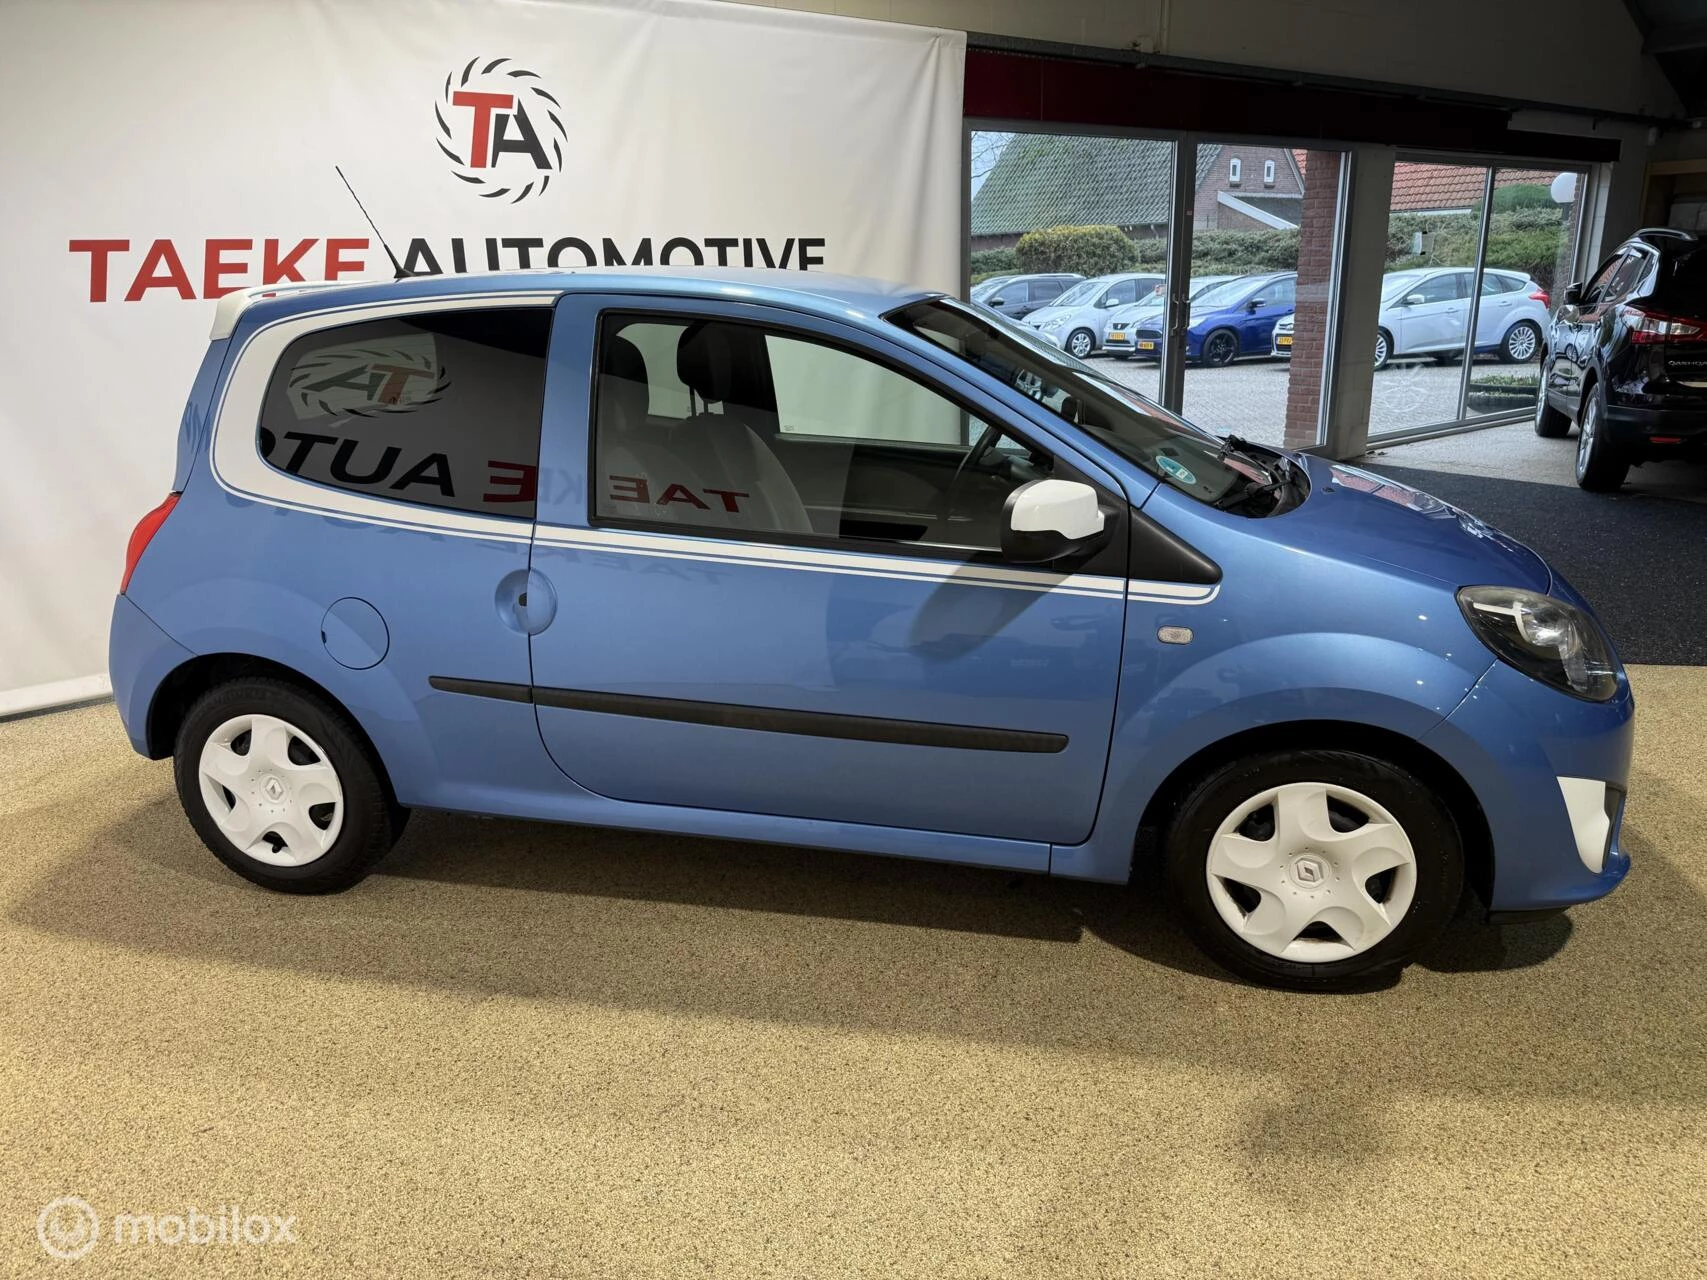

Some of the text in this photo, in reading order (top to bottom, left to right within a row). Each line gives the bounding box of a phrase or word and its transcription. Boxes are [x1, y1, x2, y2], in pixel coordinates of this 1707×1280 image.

[452, 91, 553, 170] TA
[69, 237, 826, 303] TAEKE AUTOMOTIVE
